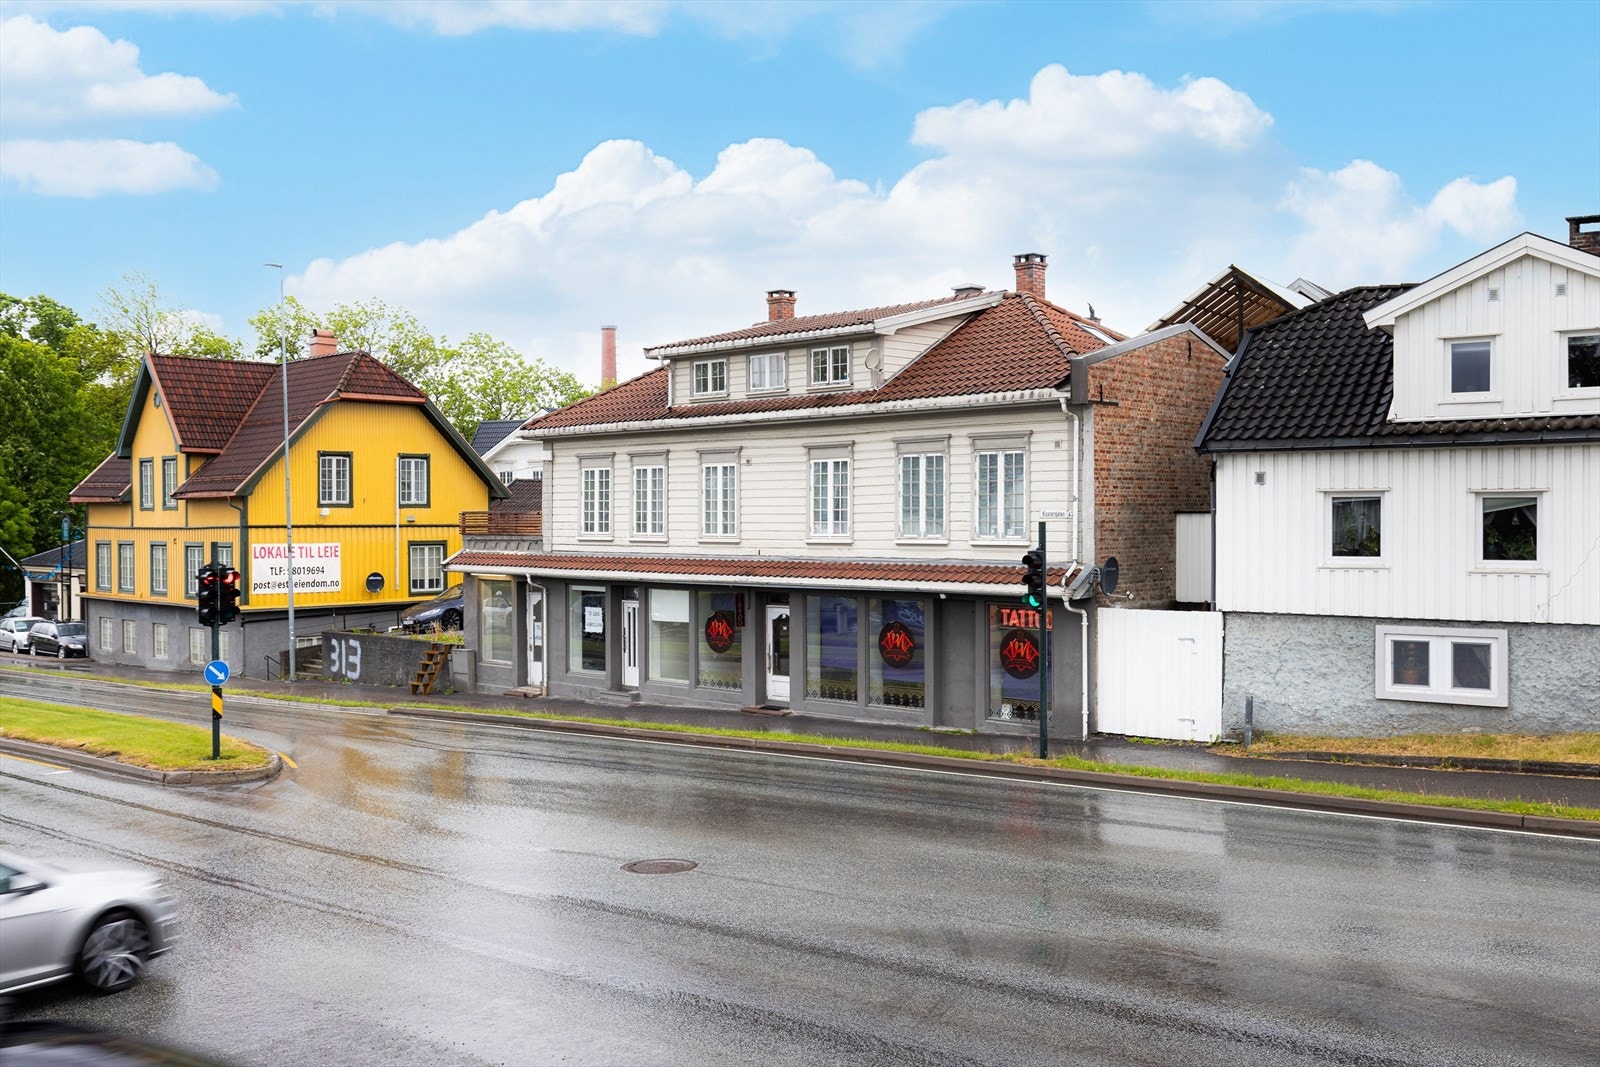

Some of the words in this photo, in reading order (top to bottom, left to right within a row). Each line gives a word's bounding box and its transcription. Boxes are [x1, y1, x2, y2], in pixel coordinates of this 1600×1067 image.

[253, 546, 295, 559] LOKALE
[298, 546, 314, 559] TIL
[318, 545, 339, 558] LEIE
[270, 566, 285, 576] TLF:
[287, 566, 325, 575] 8019694
[253, 579, 340, 591] post@esteiendom.no
[331, 638, 361, 680] 313
